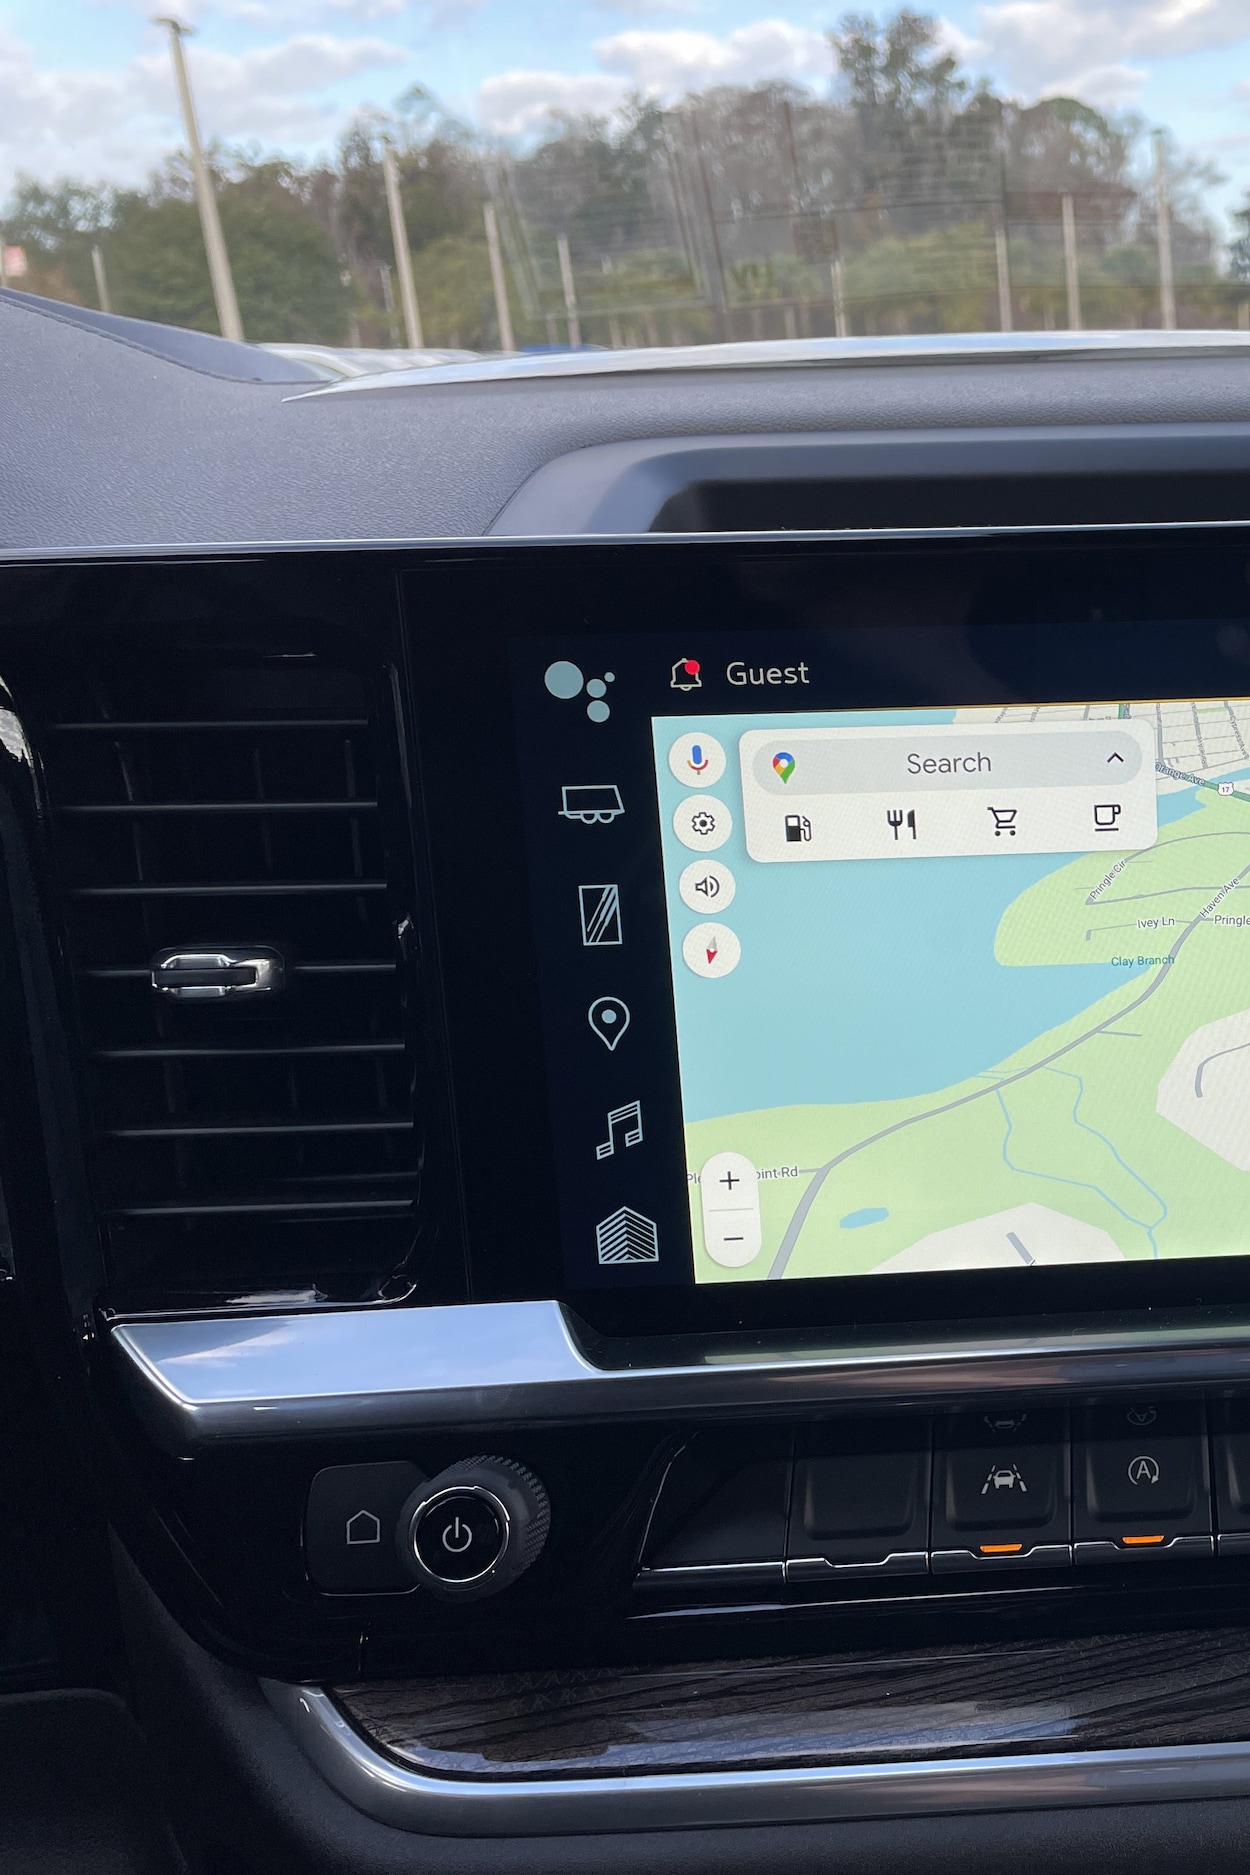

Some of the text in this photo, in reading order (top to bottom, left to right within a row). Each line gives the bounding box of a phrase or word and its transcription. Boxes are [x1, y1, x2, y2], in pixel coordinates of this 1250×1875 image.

[726, 661, 810, 686] Guest
[906, 752, 992, 776] Search
[1155, 762, 1205, 787] Orange Ave
[1089, 860, 1126, 900] Pringle Cir
[1199, 877, 1240, 918] Haven Ave
[1137, 916, 1175, 930] Ivey Ln
[1111, 955, 1175, 969] Clay Branch
[781, 1165, 798, 1178] Rd
